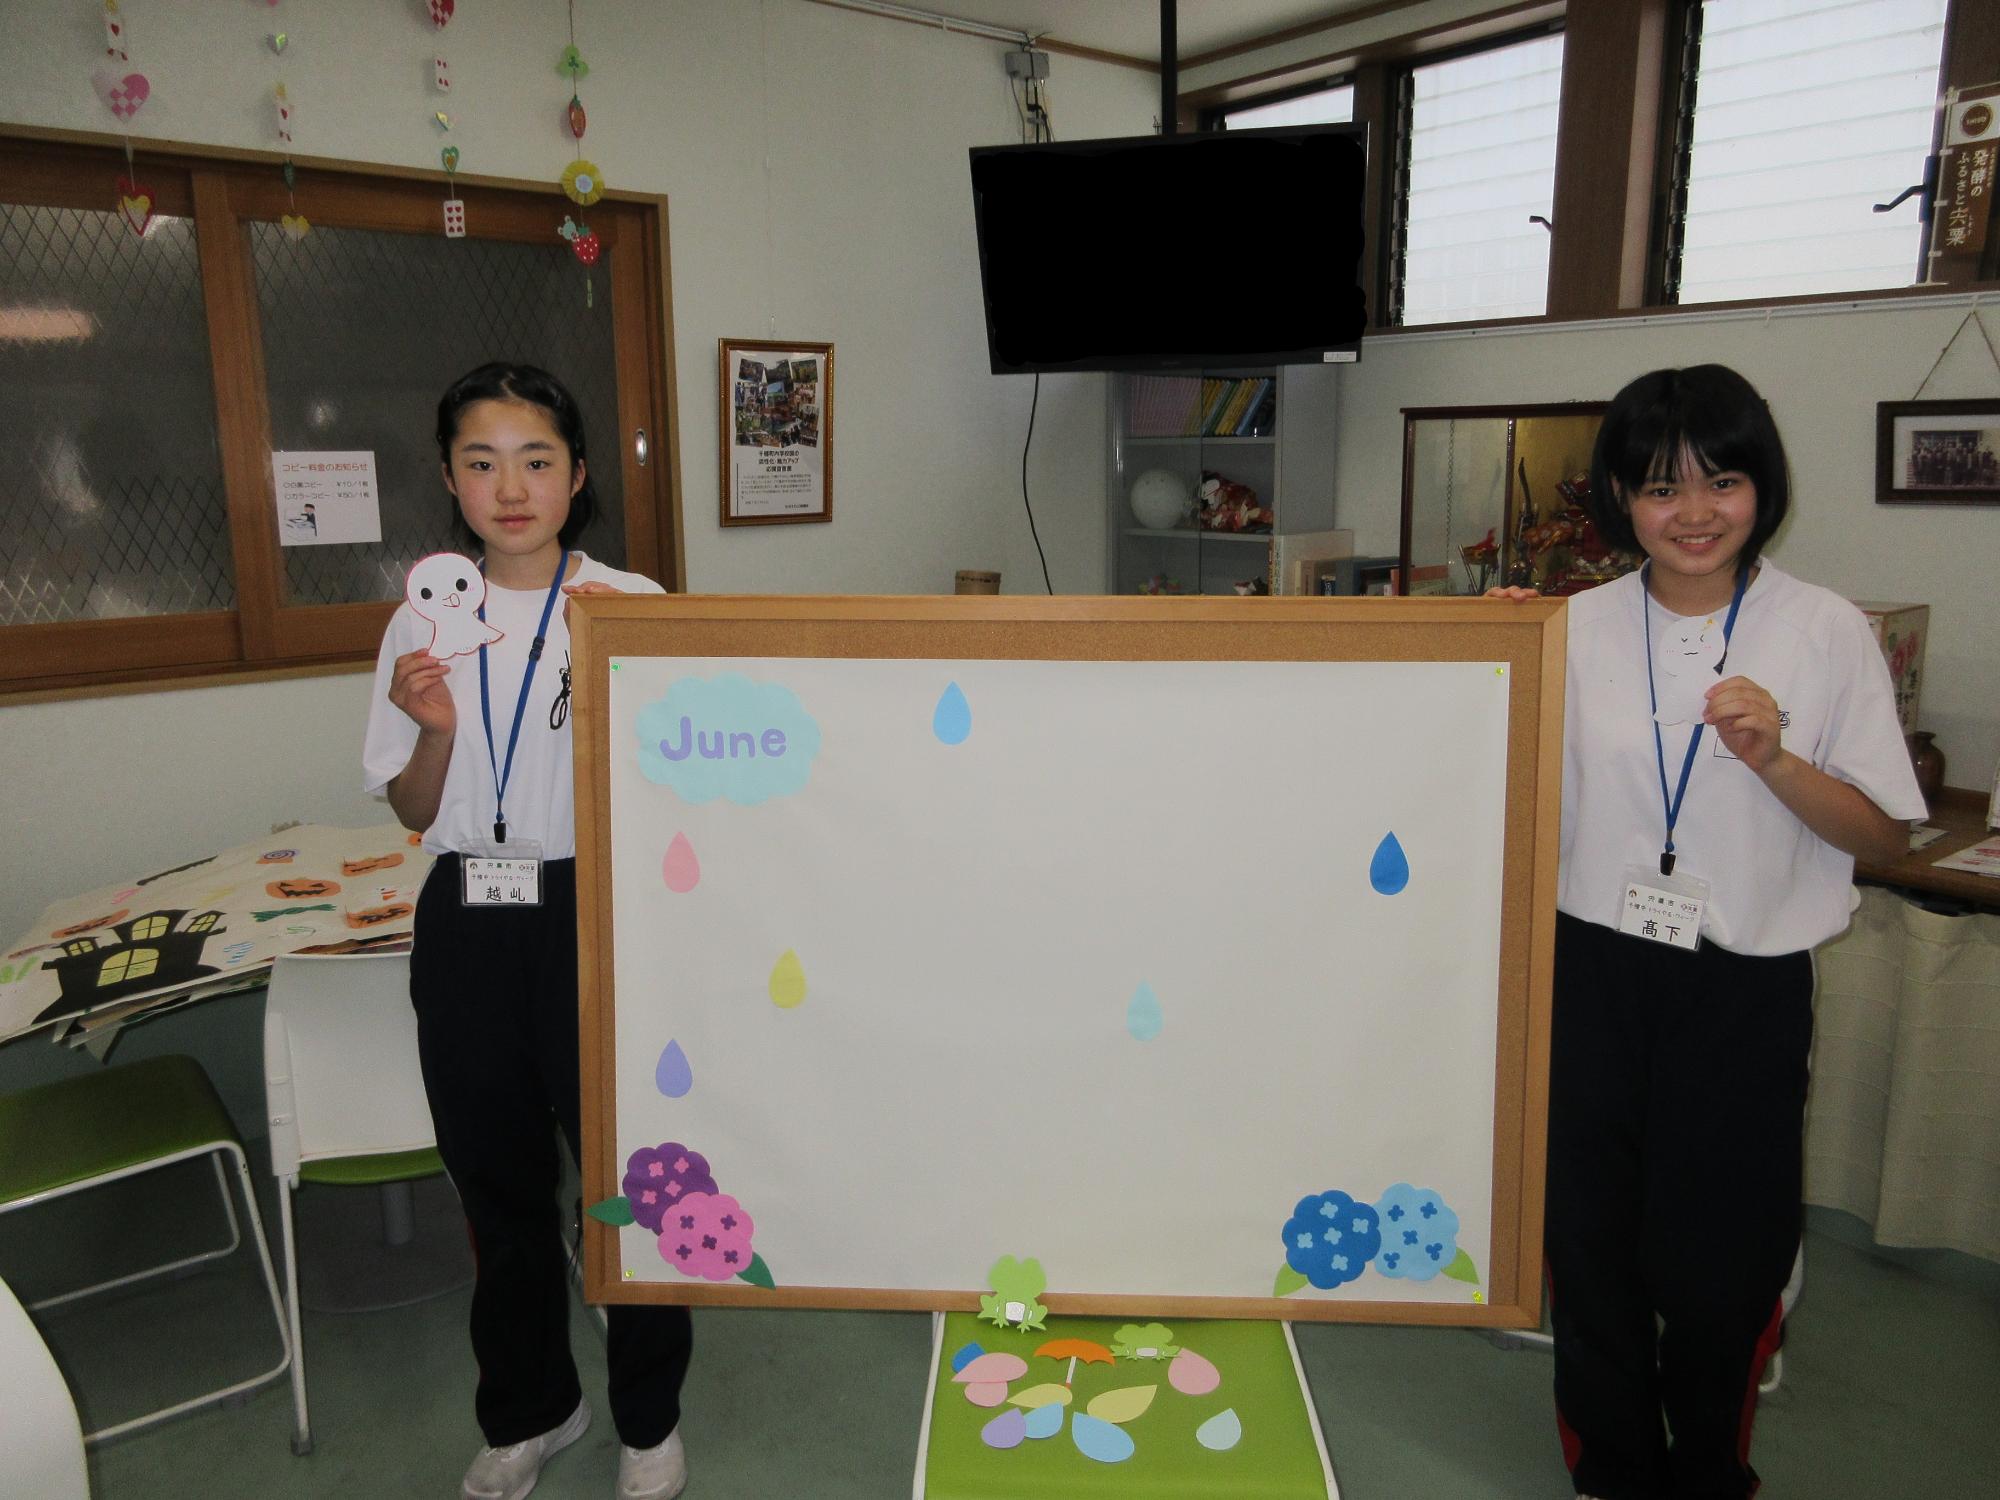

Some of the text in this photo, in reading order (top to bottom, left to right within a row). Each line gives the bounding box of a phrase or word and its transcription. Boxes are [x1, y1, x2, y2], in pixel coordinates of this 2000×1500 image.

[282, 463, 368, 472] コピー料金のお知らせ
[659, 715, 787, 761] June
